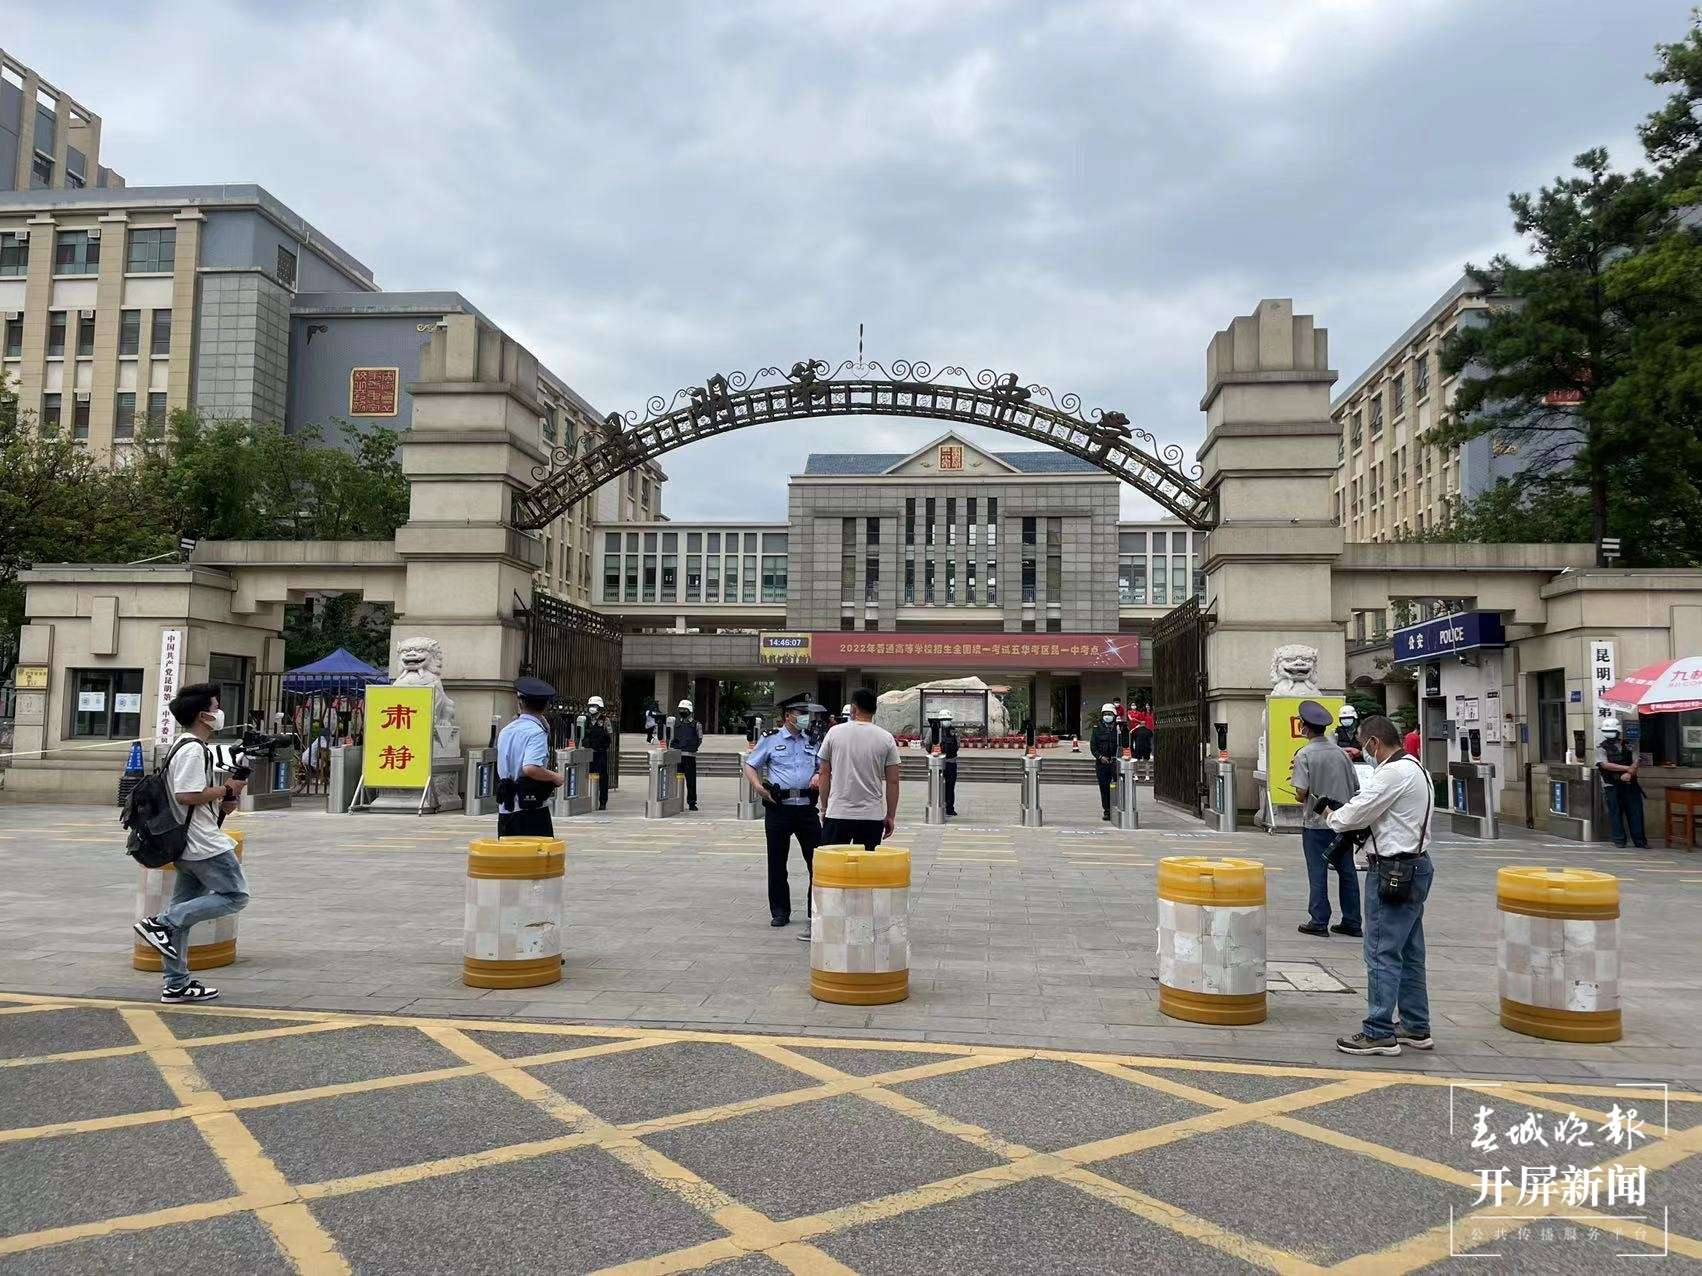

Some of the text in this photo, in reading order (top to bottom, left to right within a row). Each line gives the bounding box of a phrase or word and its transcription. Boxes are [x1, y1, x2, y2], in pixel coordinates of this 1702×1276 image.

[1408, 626, 1465, 650] 公安 POLICE
[379, 703, 418, 770] 肃静
